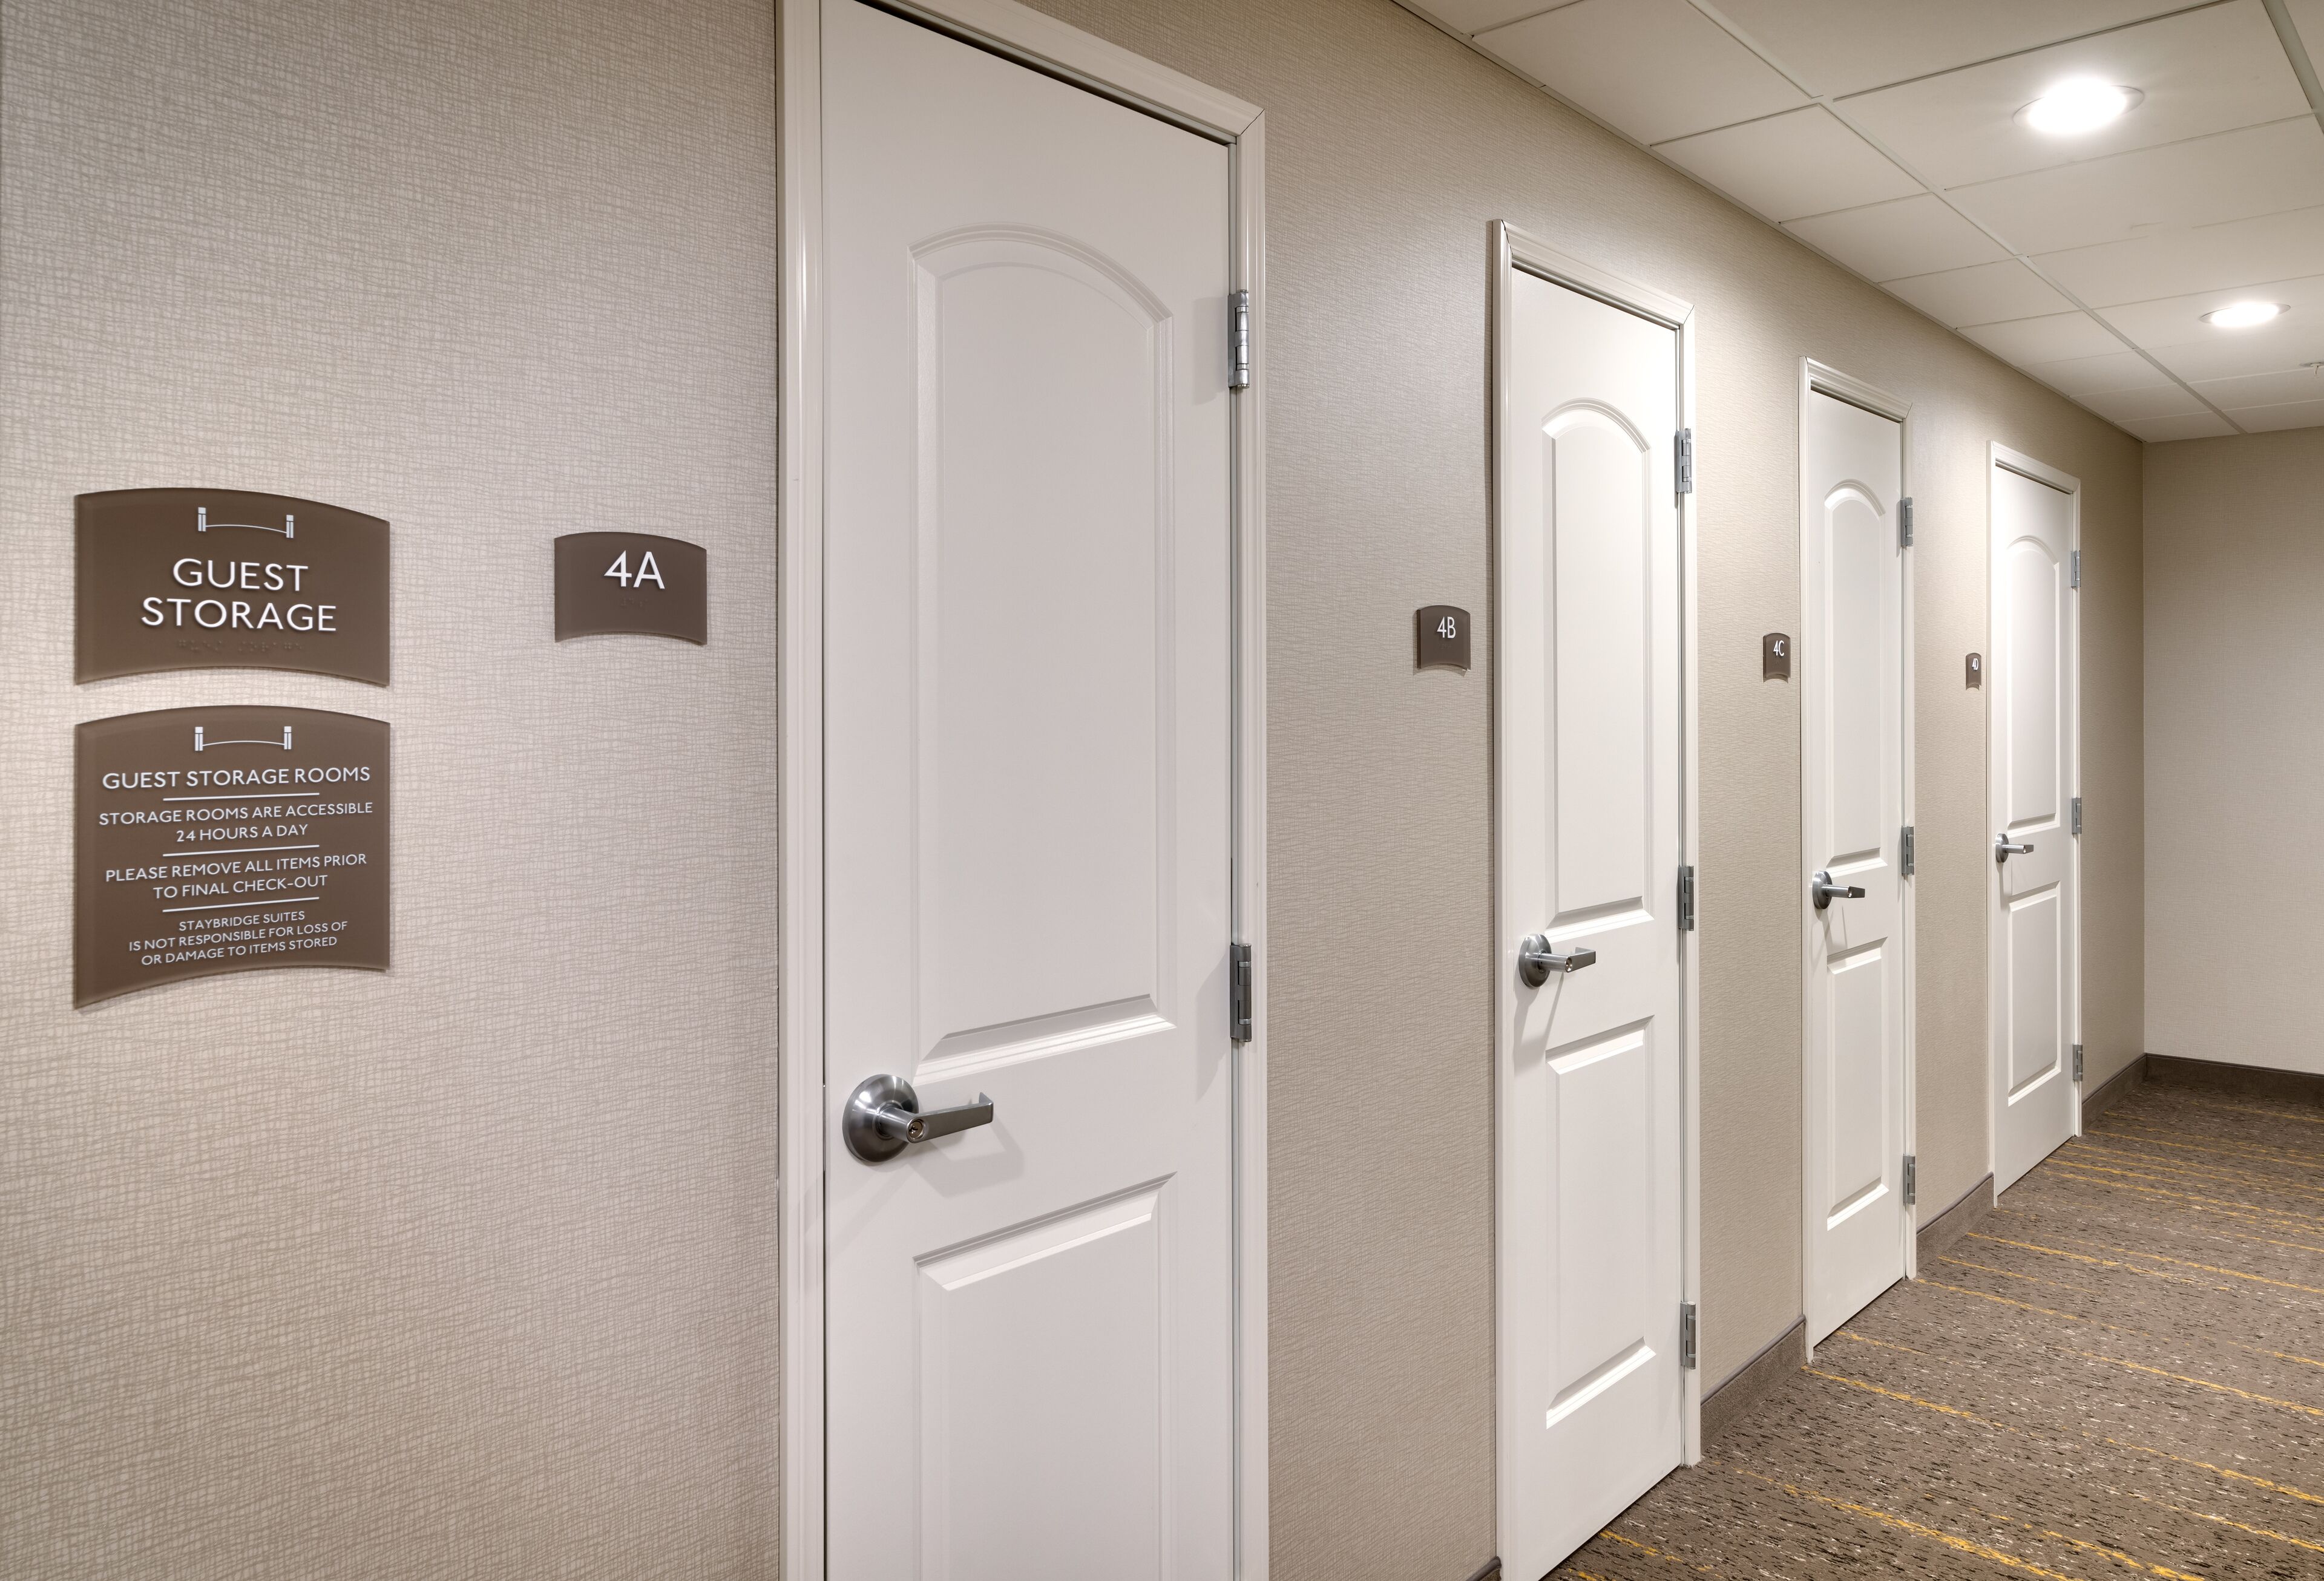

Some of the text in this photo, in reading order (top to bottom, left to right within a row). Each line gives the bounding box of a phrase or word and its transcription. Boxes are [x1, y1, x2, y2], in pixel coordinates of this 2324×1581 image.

[173, 558, 309, 591] GUEST
[604, 550, 665, 589] 4A
[141, 597, 336, 631] STORAGE
[1437, 616, 1456, 638] 4B
[1773, 640, 1785, 656] 4C
[1972, 658, 1979, 670] 4D
[102, 767, 370, 789] GUEST STORAGE ROOMS
[99, 802, 373, 825] STORAGE ROOMS ARE ACCESSIBLE
[176, 823, 308, 842] 24 HOURS A DAY
[106, 853, 367, 882] PLEASE REMOVE ALL ITEMS PRIOR
[153, 874, 328, 899] TO FINAL CHECK-OUT
[179, 911, 305, 931] STAYBRIDGE SUITES
[130, 921, 348, 951] IS NOT RESPONSIBLE FOR LOSS OF
[141, 937, 337, 966] OR DAMAGE TO ITEMS STORED
